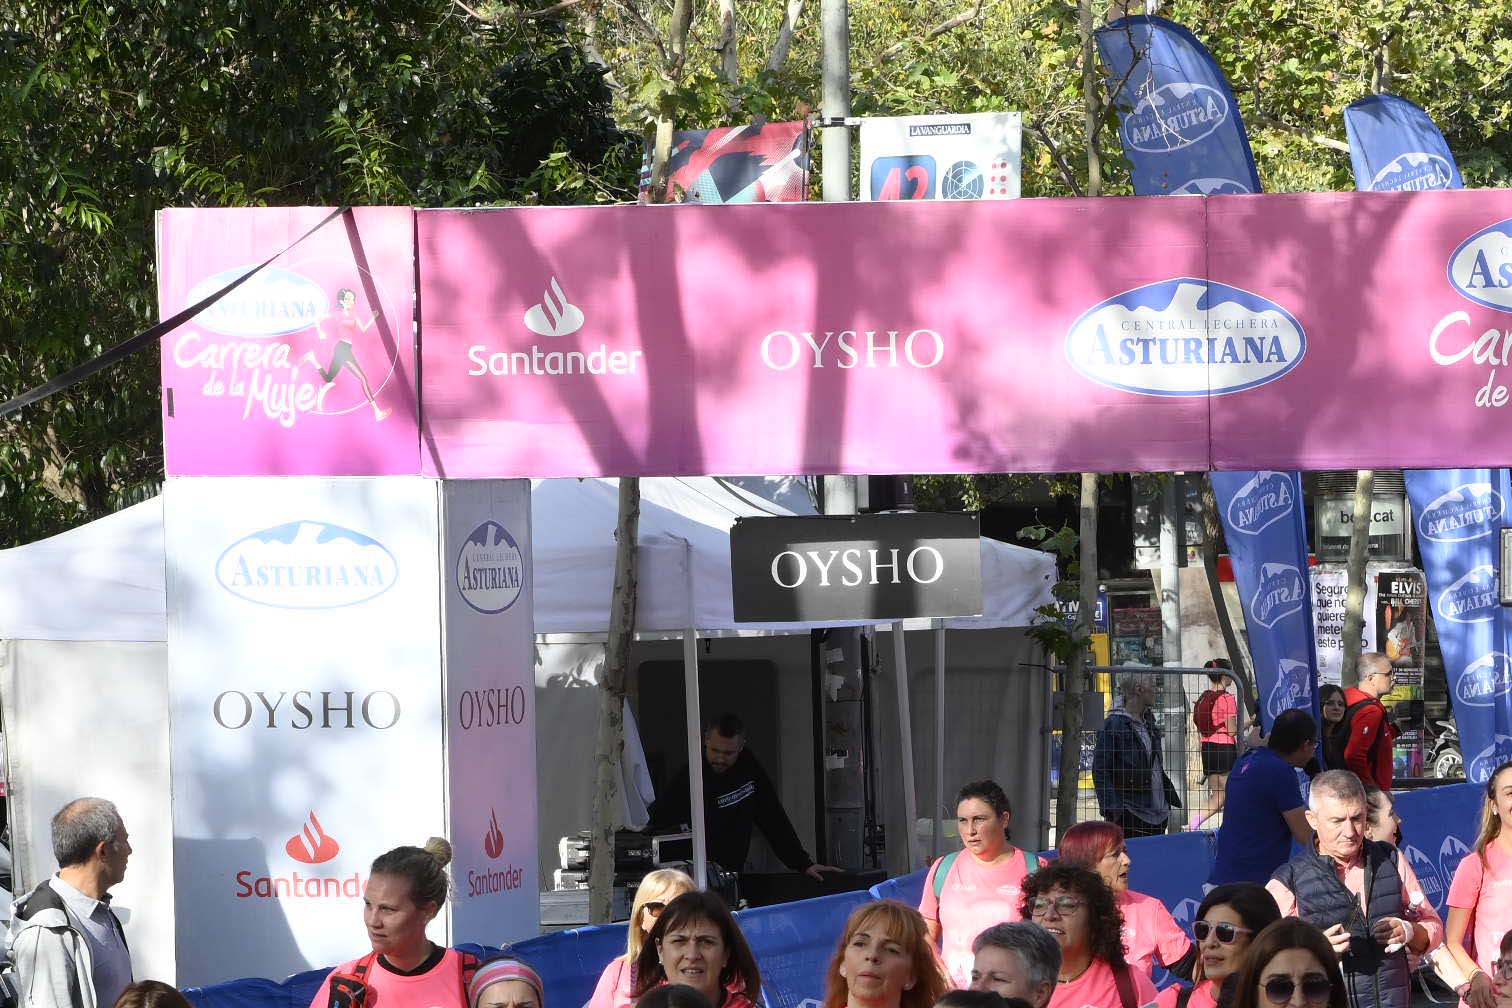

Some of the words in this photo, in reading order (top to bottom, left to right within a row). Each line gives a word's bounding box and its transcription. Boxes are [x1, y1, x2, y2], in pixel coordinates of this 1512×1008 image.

[1121, 319, 1200, 332] CENTRAL
[173, 331, 293, 369] Carrera
[468, 344, 642, 377] Santander
[760, 329, 945, 371] OYSHO
[1086, 323, 1289, 367] ASTURIANA
[202, 371, 225, 396] de
[229, 371, 246, 396] la
[242, 365, 337, 429] Mujer
[1475, 369, 1509, 407] de
[231, 554, 385, 588] ASTURIANA
[462, 560, 520, 591] ASTURIANA
[772, 547, 944, 589] OYSHO
[1316, 599, 1332, 609] que
[1391, 581, 1421, 595] ELVIS
[1318, 638, 1337, 648] este
[213, 689, 401, 730] OYSHO
[459, 686, 525, 730] OYSHO
[468, 865, 524, 898] Santander
